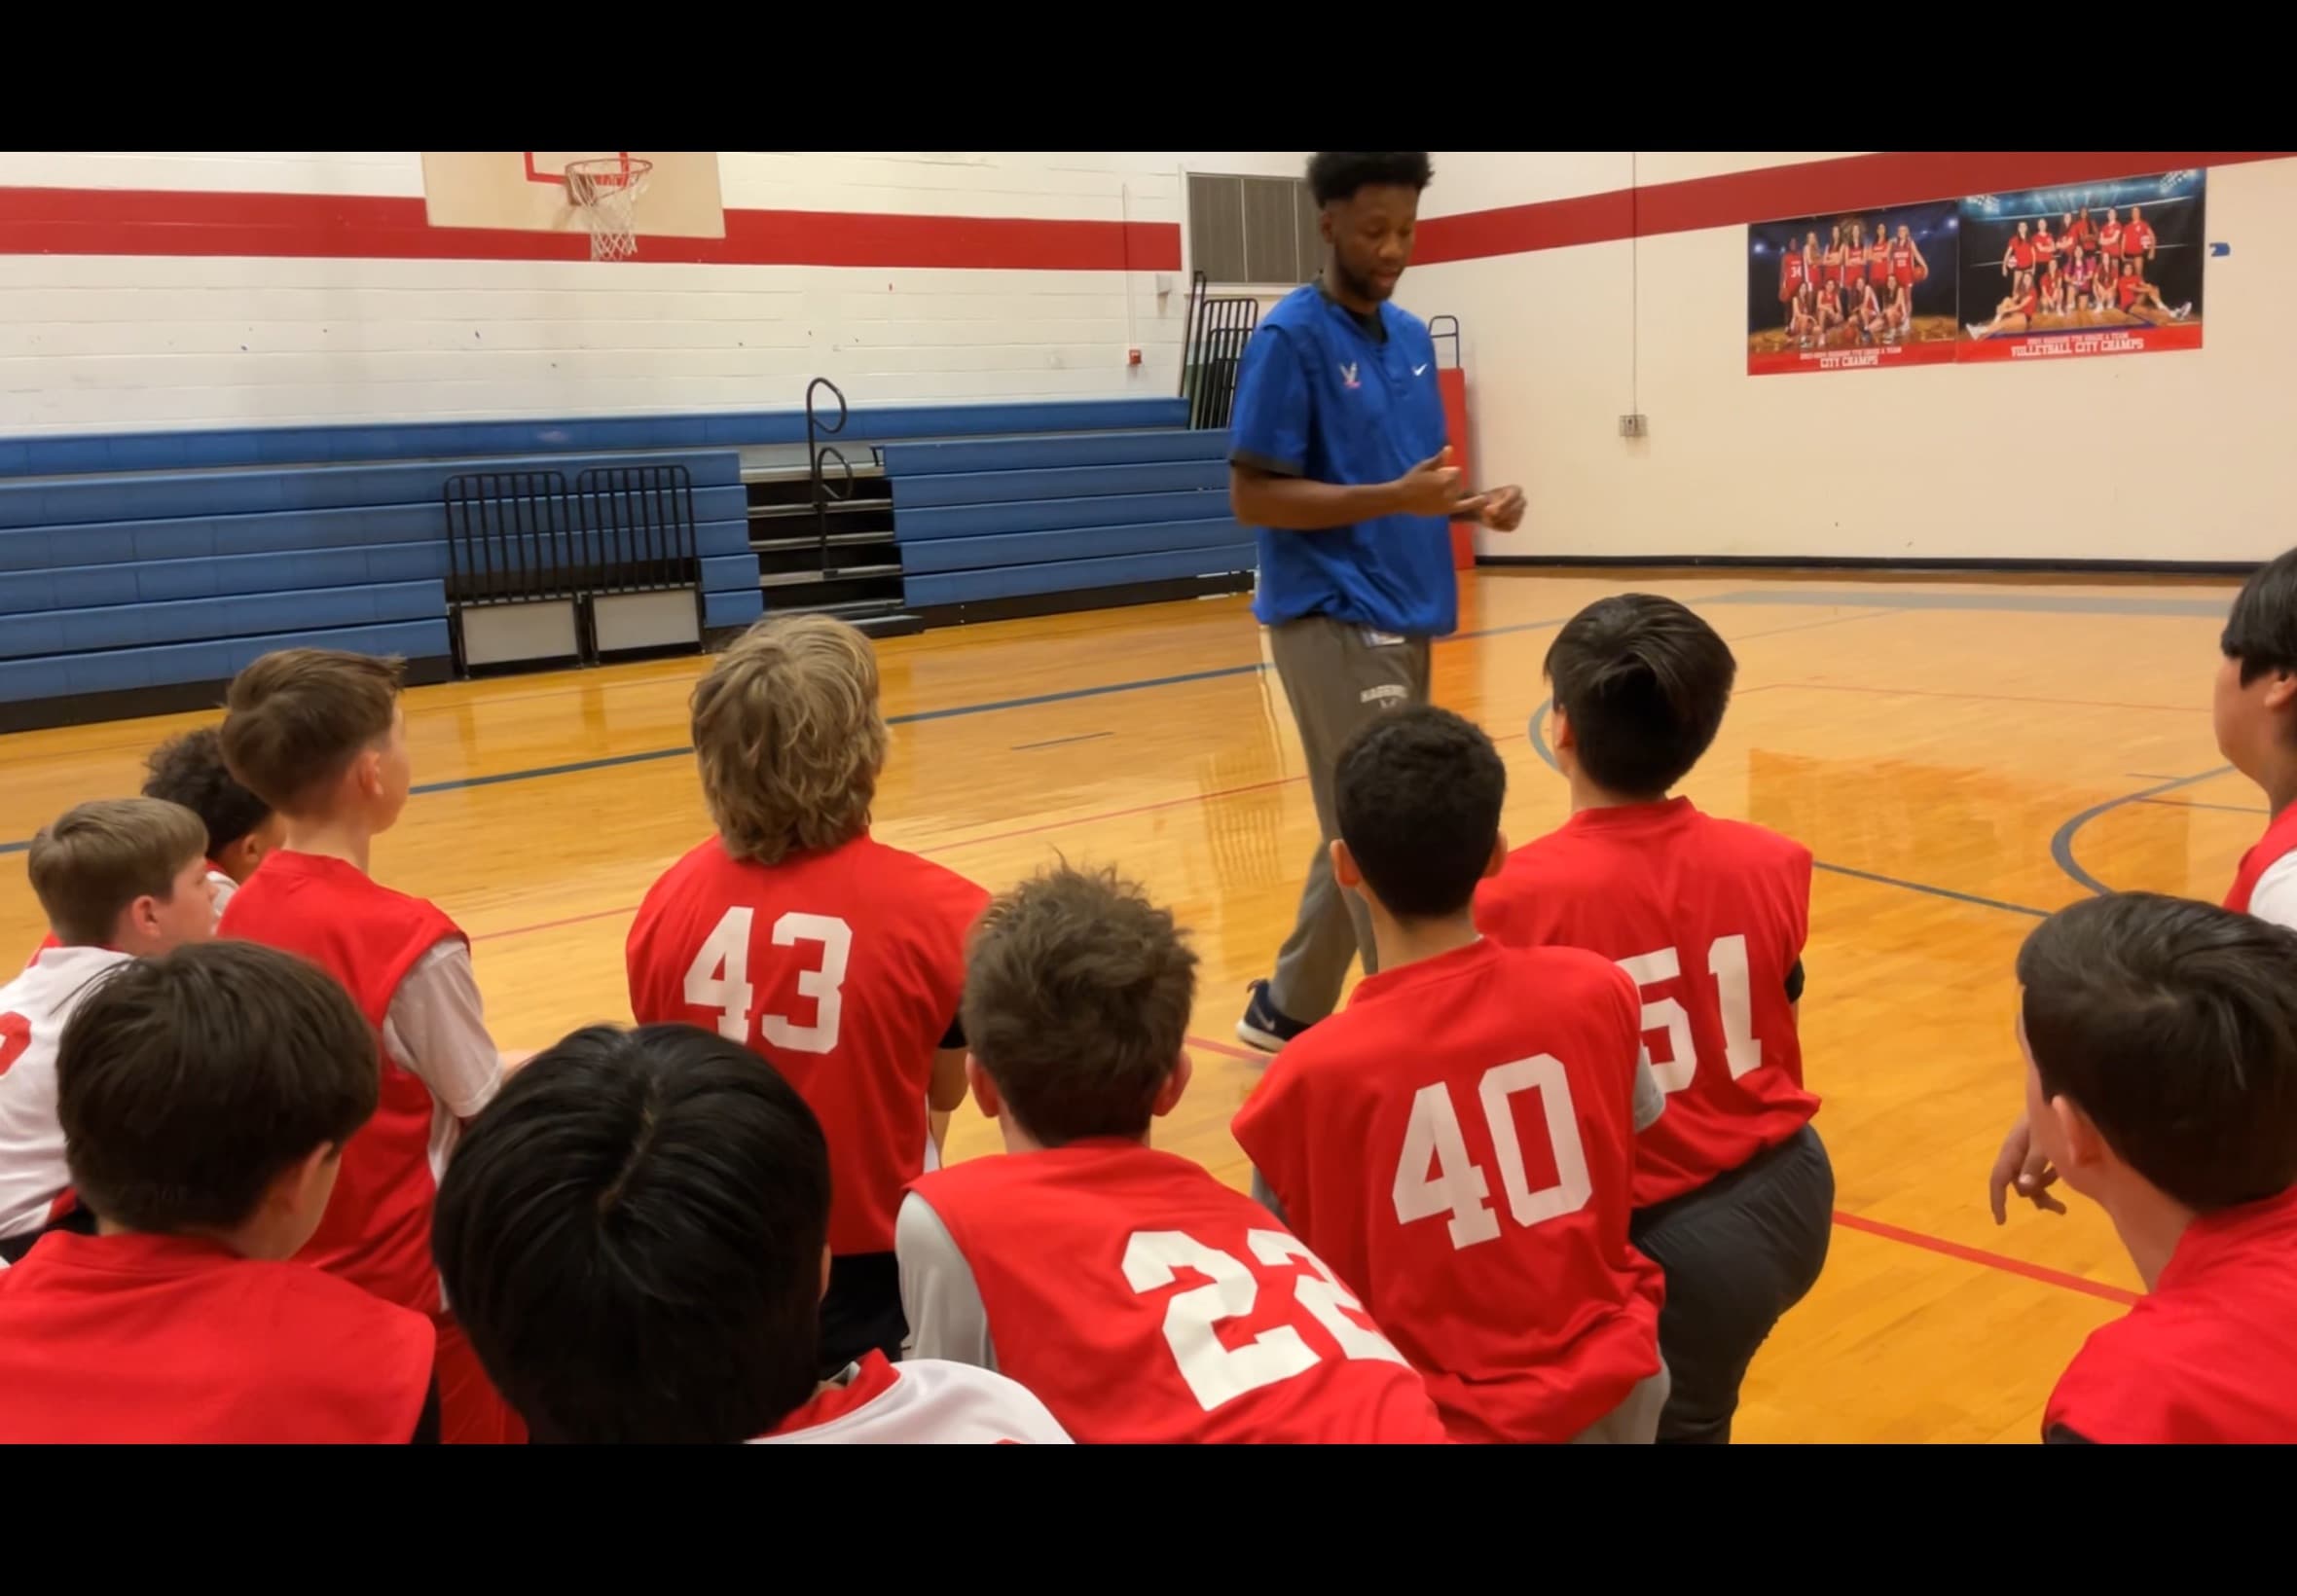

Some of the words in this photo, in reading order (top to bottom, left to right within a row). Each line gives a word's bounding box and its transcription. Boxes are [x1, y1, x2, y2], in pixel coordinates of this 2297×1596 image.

[1820, 357, 1839, 368] CITY
[1841, 355, 1878, 366] CHAMPS
[2011, 342, 2072, 357] VOLLEYBALL
[2075, 341, 2098, 352] CITY
[2100, 338, 2144, 351] CHAMPS
[683, 906, 853, 1055] 43
[1615, 934, 1763, 1094] 51
[1392, 1053, 1593, 1251] 40
[1121, 1228, 1411, 1412] 22
